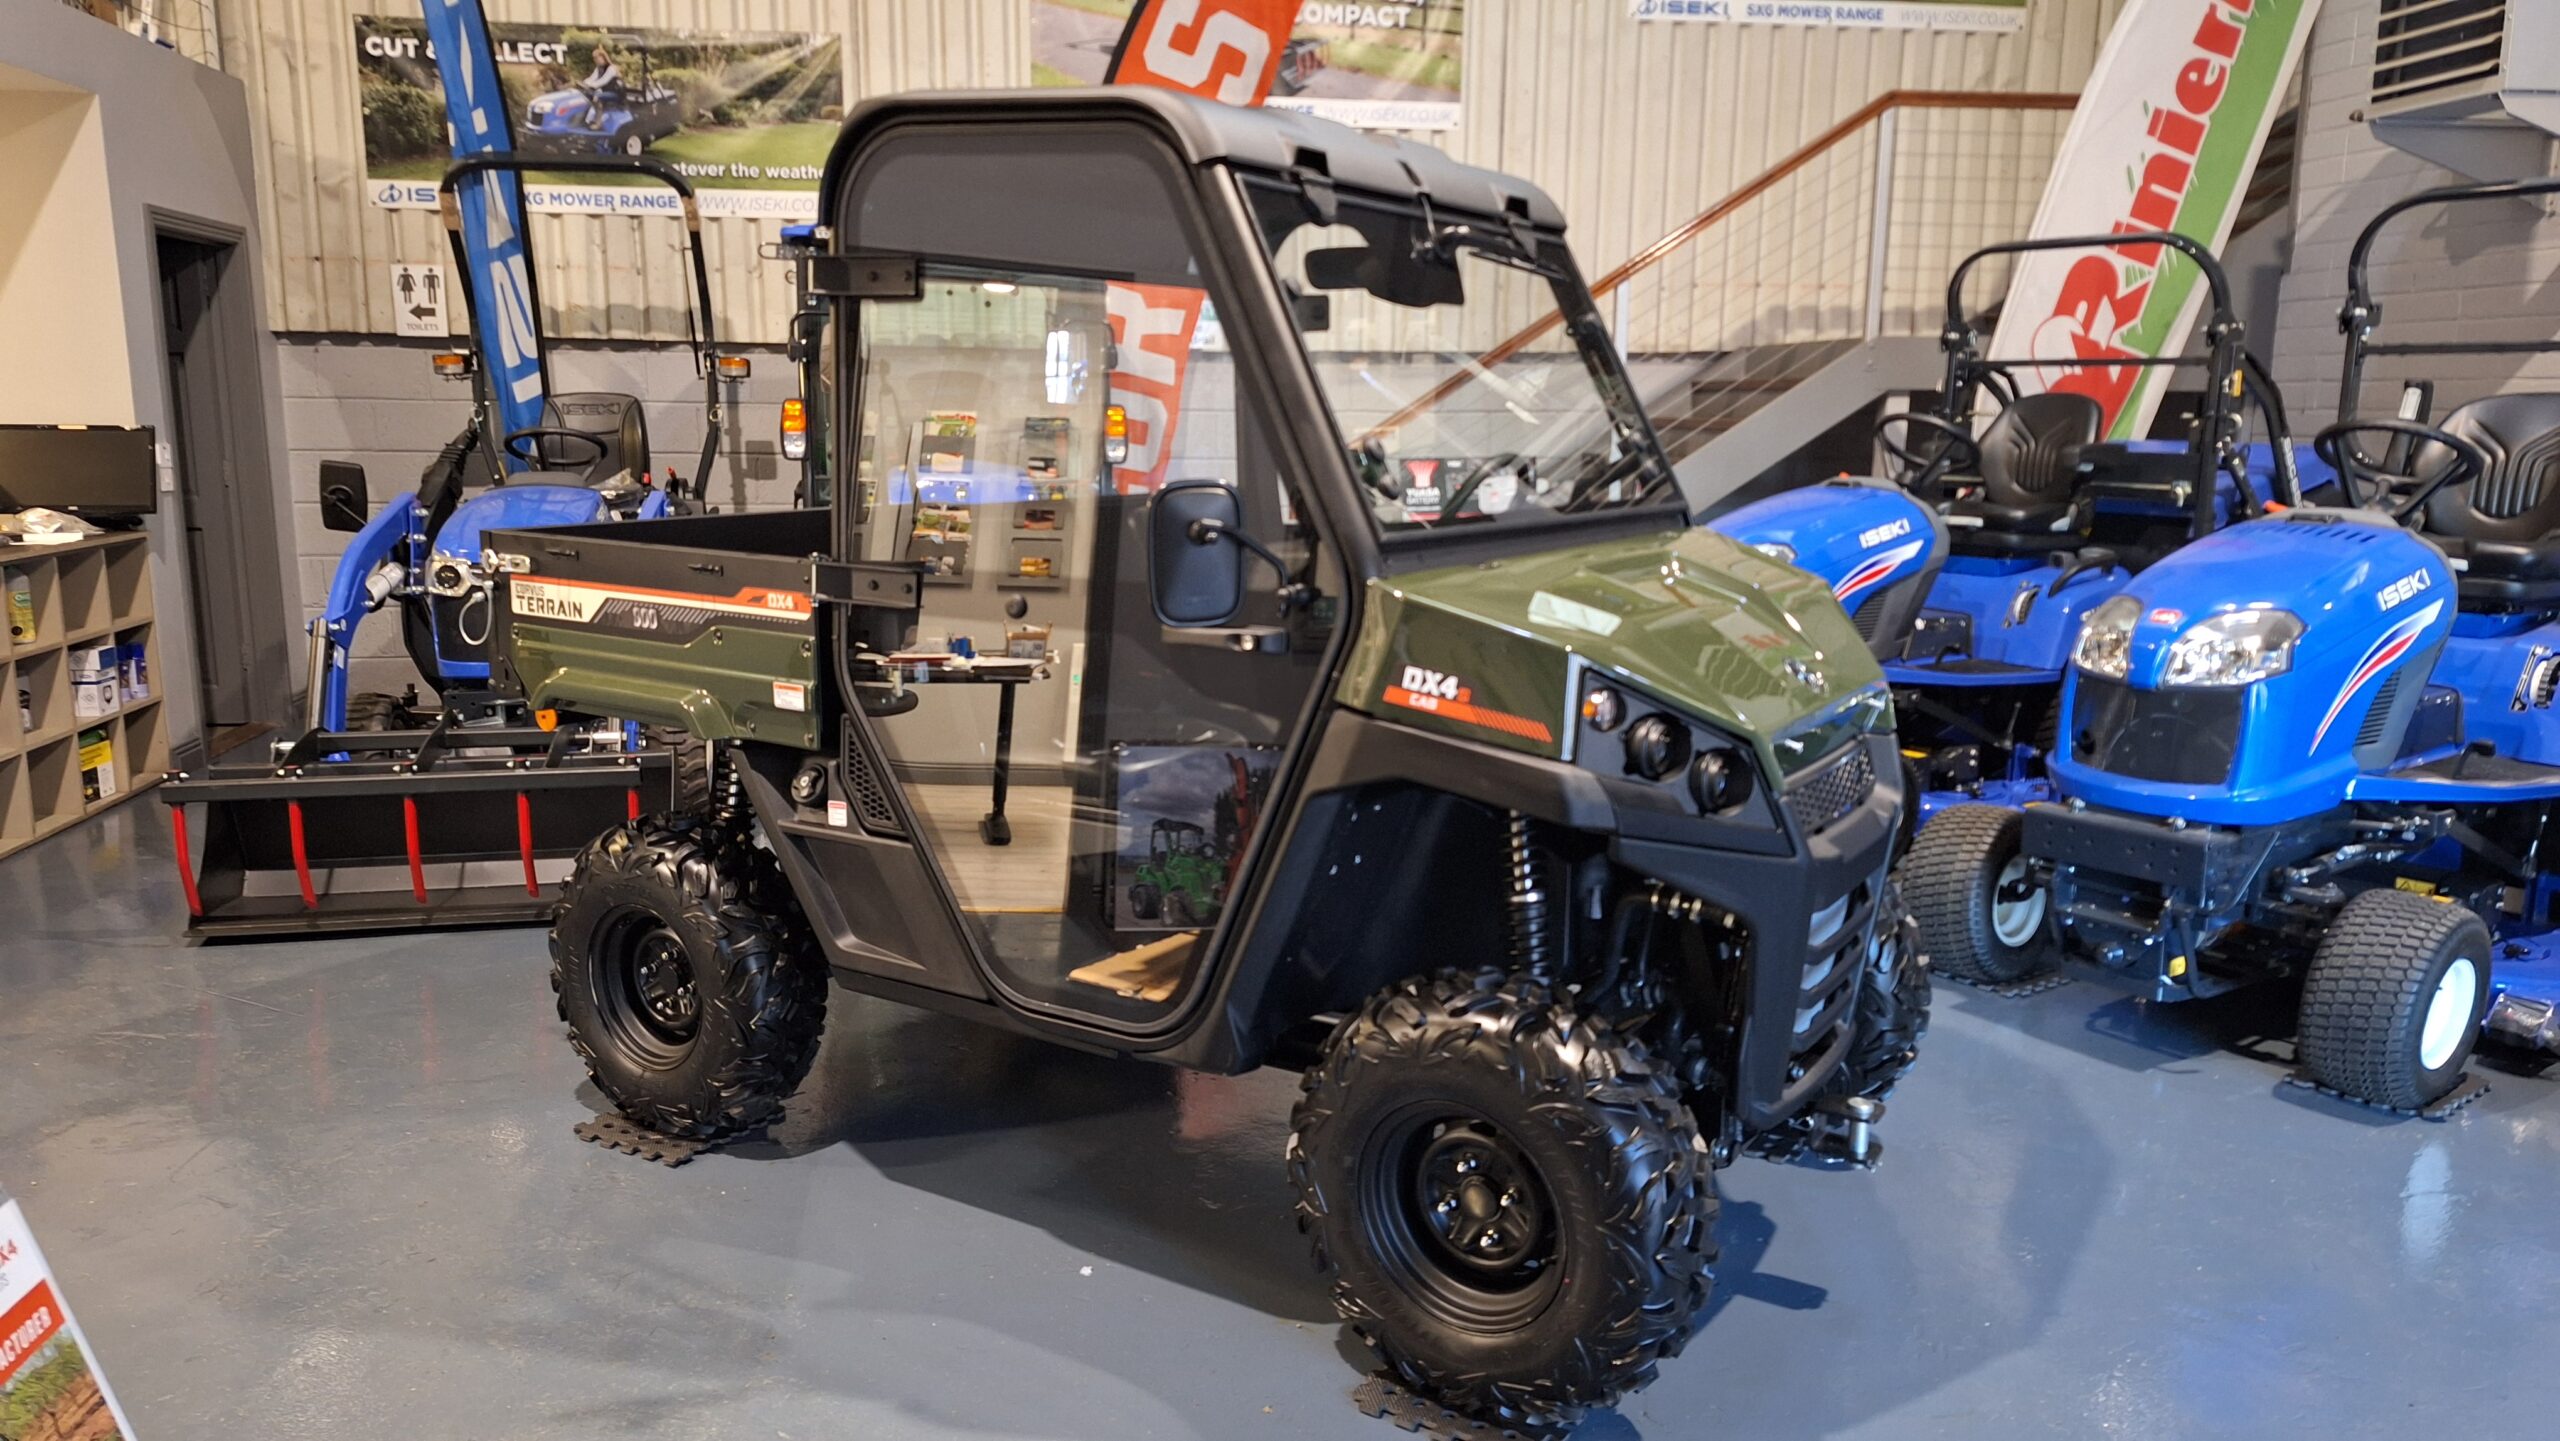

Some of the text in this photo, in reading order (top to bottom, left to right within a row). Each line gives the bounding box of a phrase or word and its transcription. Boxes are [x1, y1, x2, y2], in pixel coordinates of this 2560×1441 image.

[1295, 4, 1412, 28] OMPACT
[1660, 0, 1729, 16] ISEKI
[1777, 5, 1832, 19] MOWER
[1836, 8, 1885, 21] RANGE
[364, 35, 420, 59] CUT
[730, 161, 761, 179] the
[549, 192, 615, 209] MOWER
[619, 194, 678, 209] RANGE
[406, 322, 440, 332] TOILETS
[561, 402, 621, 416] ISEKI
[1859, 517, 1911, 549] ISEKI
[2377, 567, 2431, 612] ISEKI
[516, 595, 583, 620] TERRAIN
[767, 592, 795, 609] DX4
[1401, 665, 1459, 700] DX4
